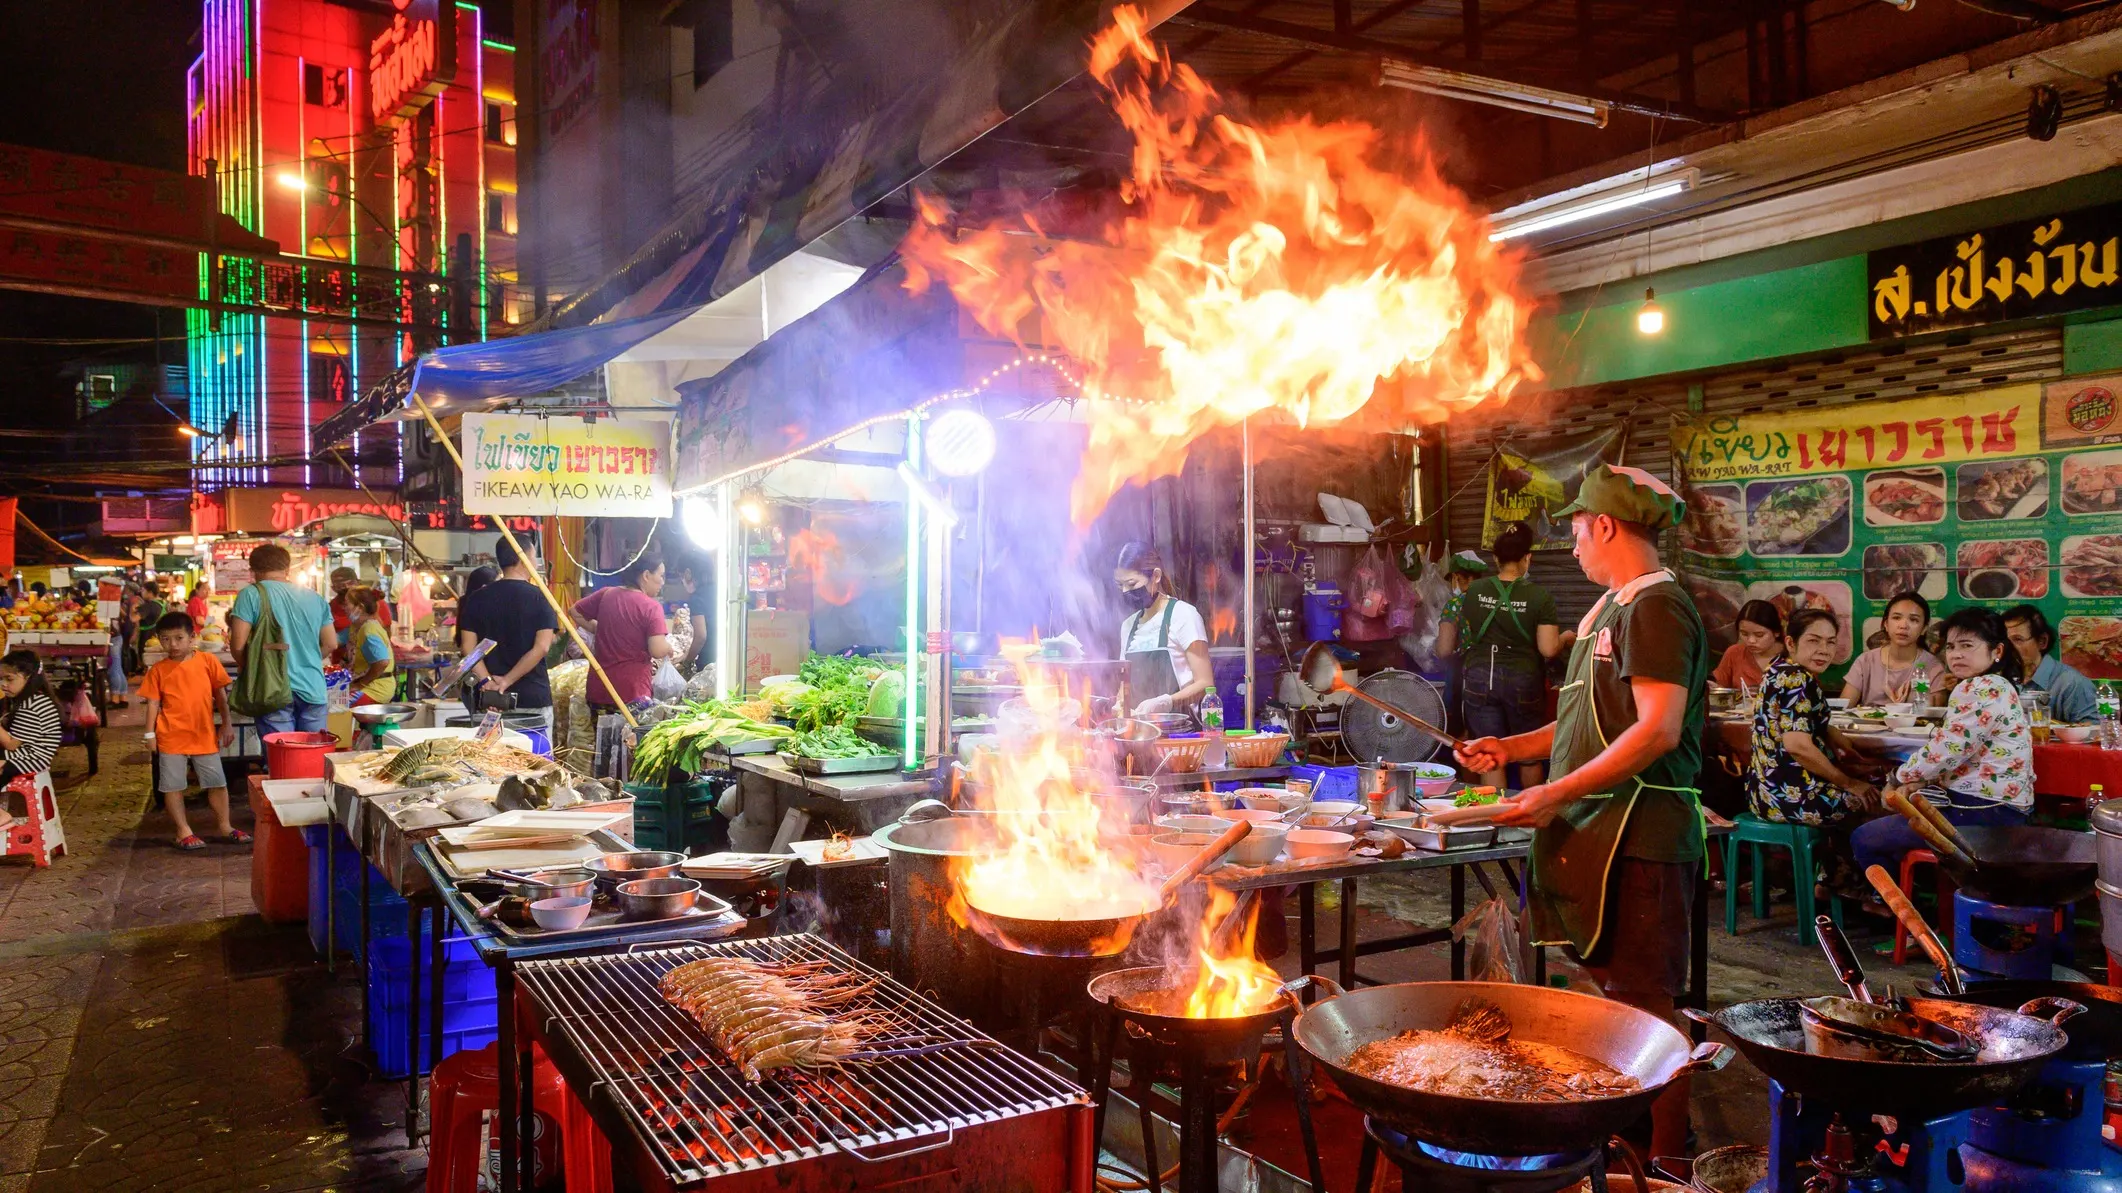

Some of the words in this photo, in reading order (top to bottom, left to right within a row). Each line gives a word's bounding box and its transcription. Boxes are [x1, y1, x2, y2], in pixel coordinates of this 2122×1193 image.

[1874, 218, 2119, 322] ส.เป้งง้วน
[472, 426, 560, 473] ไฟเขียว
[1797, 405, 2020, 470] เยาวราช
[474, 481, 542, 499] FIKEAW
[549, 483, 588, 499] YAO
[596, 484, 654, 501] WA-RA
